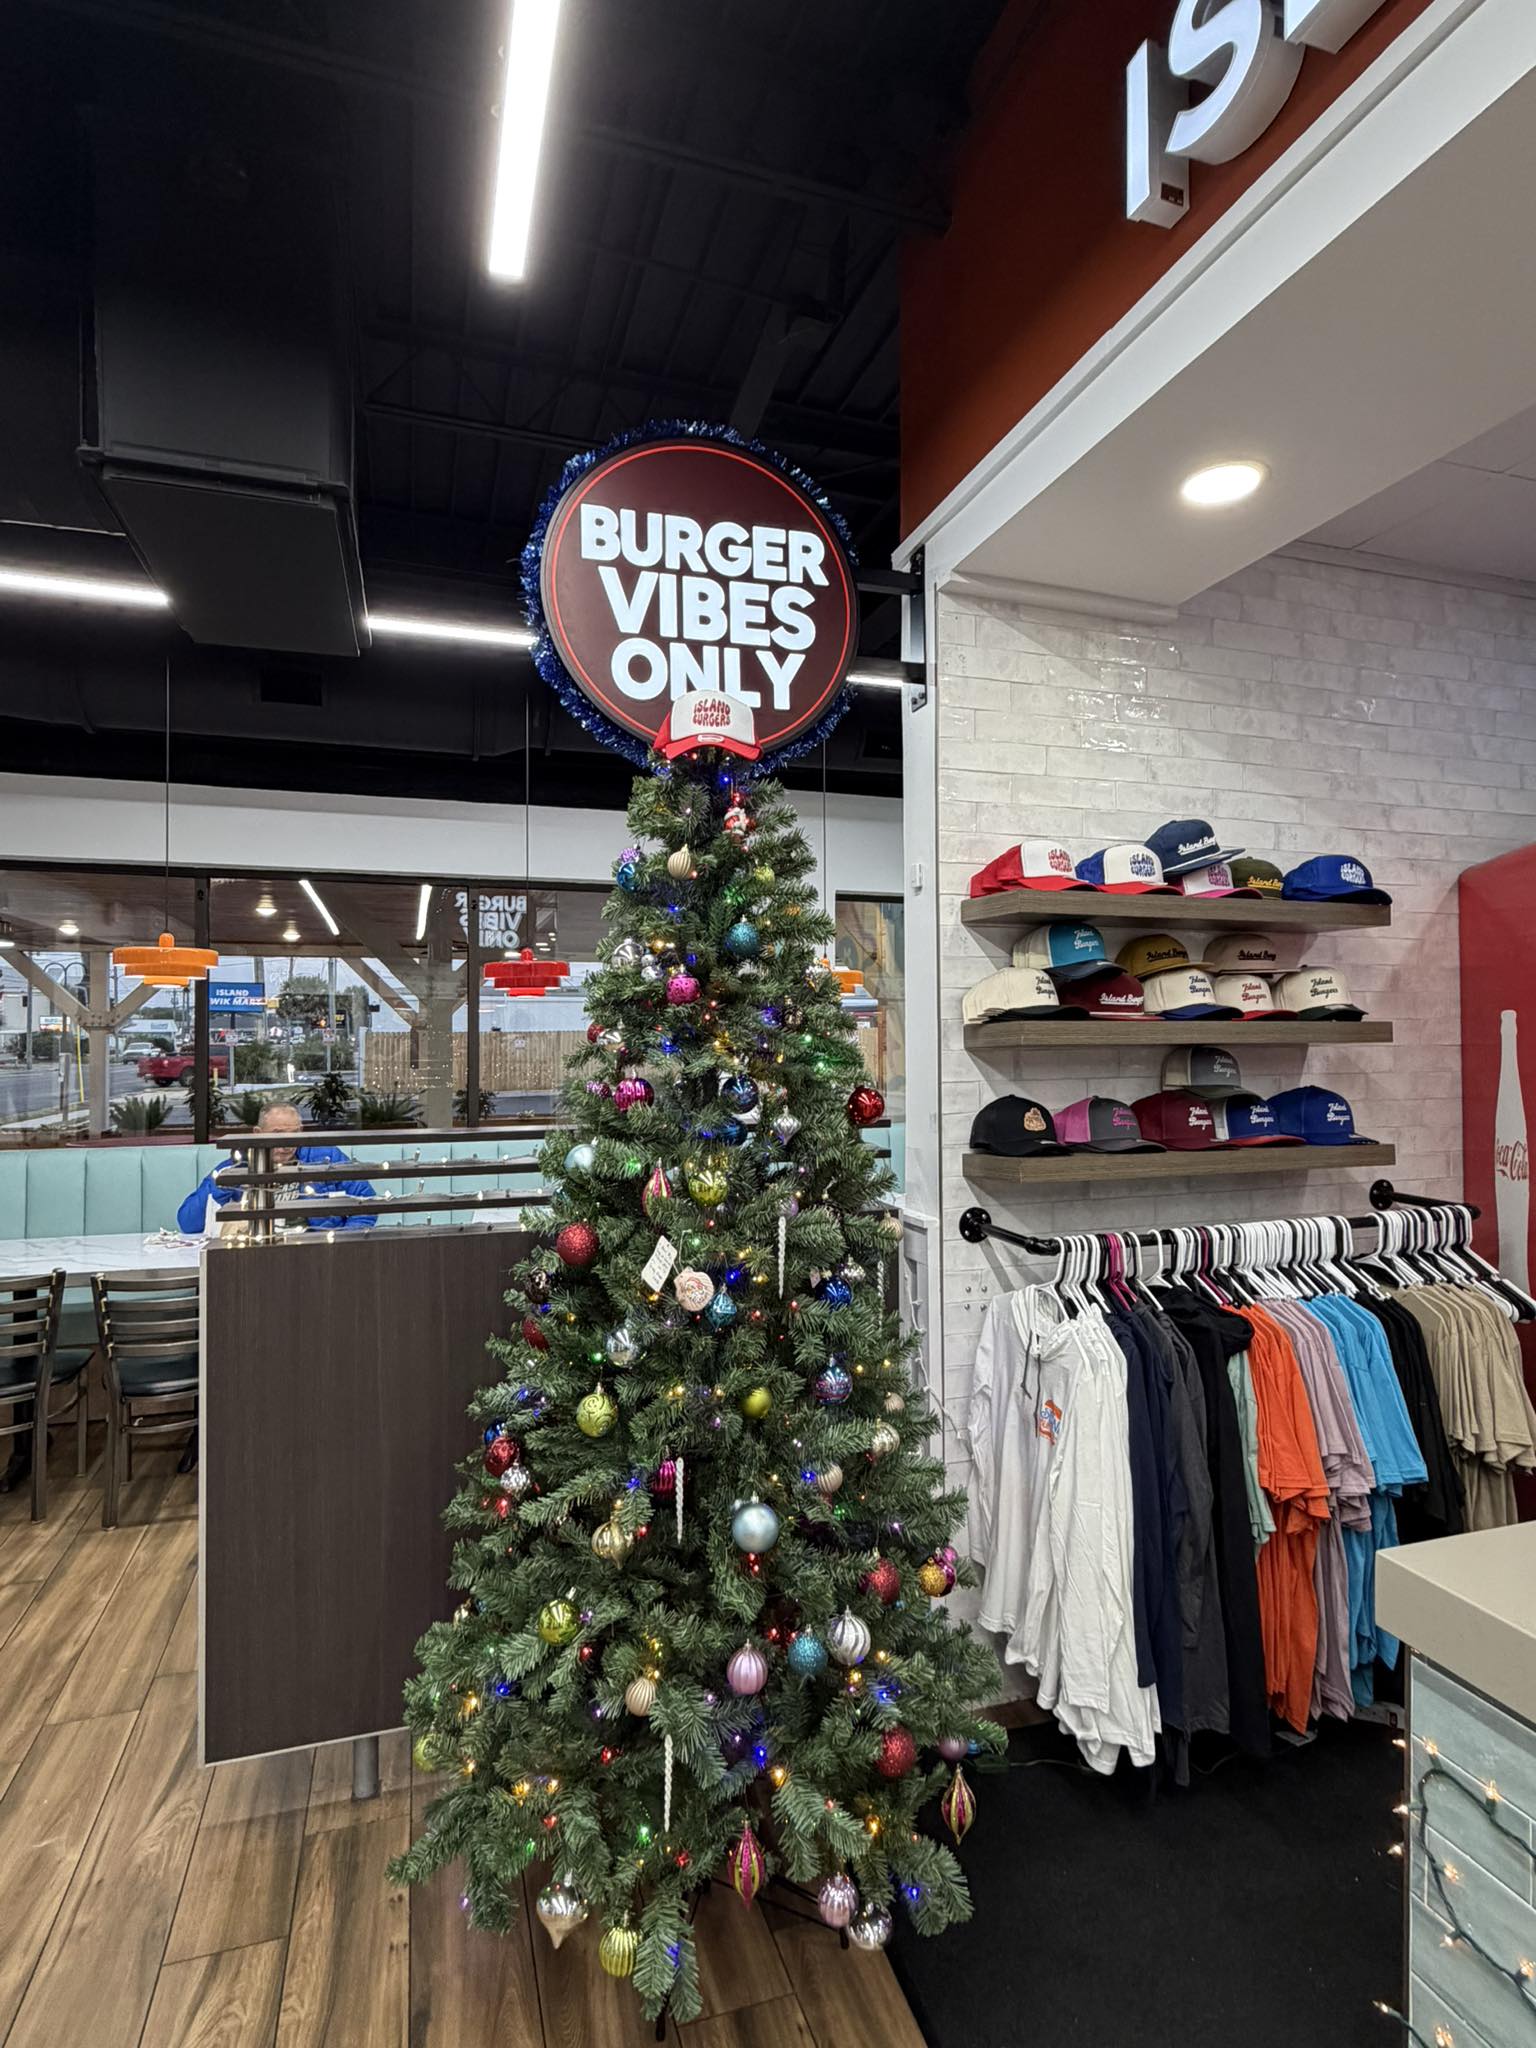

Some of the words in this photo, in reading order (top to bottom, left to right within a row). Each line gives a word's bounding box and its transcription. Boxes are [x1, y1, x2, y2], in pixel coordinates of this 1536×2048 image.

[1126, 0, 1325, 222] IS
[580, 503, 829, 586] BURGER
[597, 566, 816, 650] VIBES
[611, 637, 806, 711] ONLY
[694, 698, 731, 715] ISLAND
[692, 713, 731, 727] BURGERS
[1177, 838, 1203, 855] Island
[1129, 852, 1155, 865] ISLAND
[1247, 876, 1270, 887] Island
[1146, 949, 1171, 960] Island
[1310, 975, 1334, 987] Island
[215, 989, 249, 997] ISLAND
[1099, 992, 1126, 1003] Island
